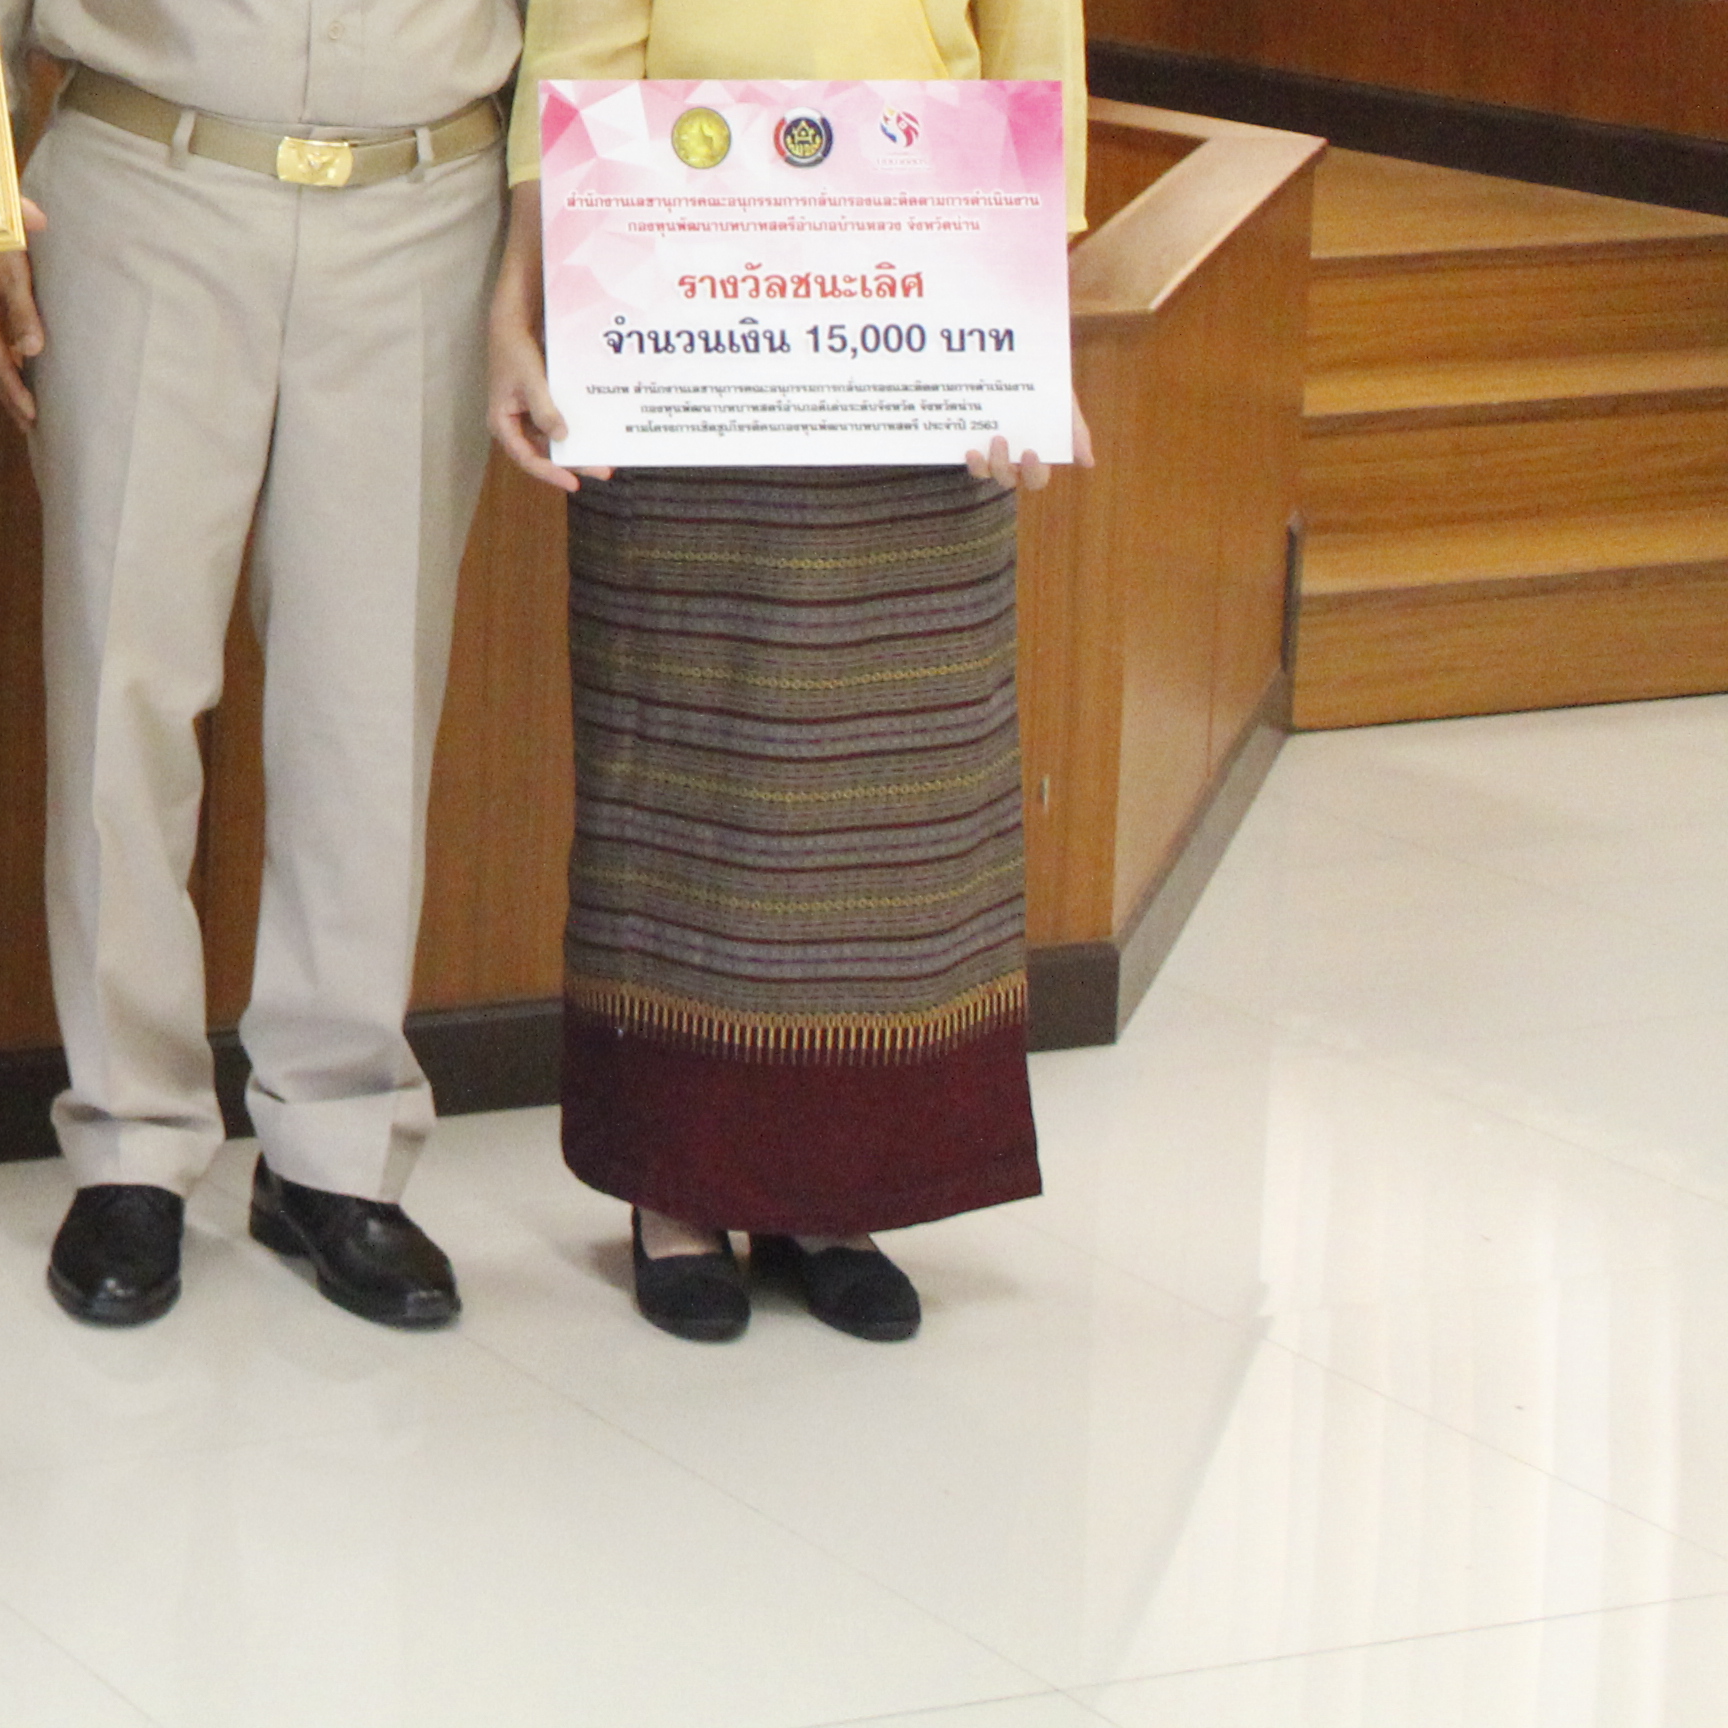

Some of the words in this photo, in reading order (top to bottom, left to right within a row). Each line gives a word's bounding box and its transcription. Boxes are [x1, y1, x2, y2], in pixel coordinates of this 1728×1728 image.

[907, 218, 981, 232] จังหวัดน่าน
[678, 262, 924, 299] รางวัลชนะเลิศ
[603, 316, 791, 354] จำนวนเงิน
[806, 323, 927, 359] 15,000
[940, 328, 1015, 352] บาท
